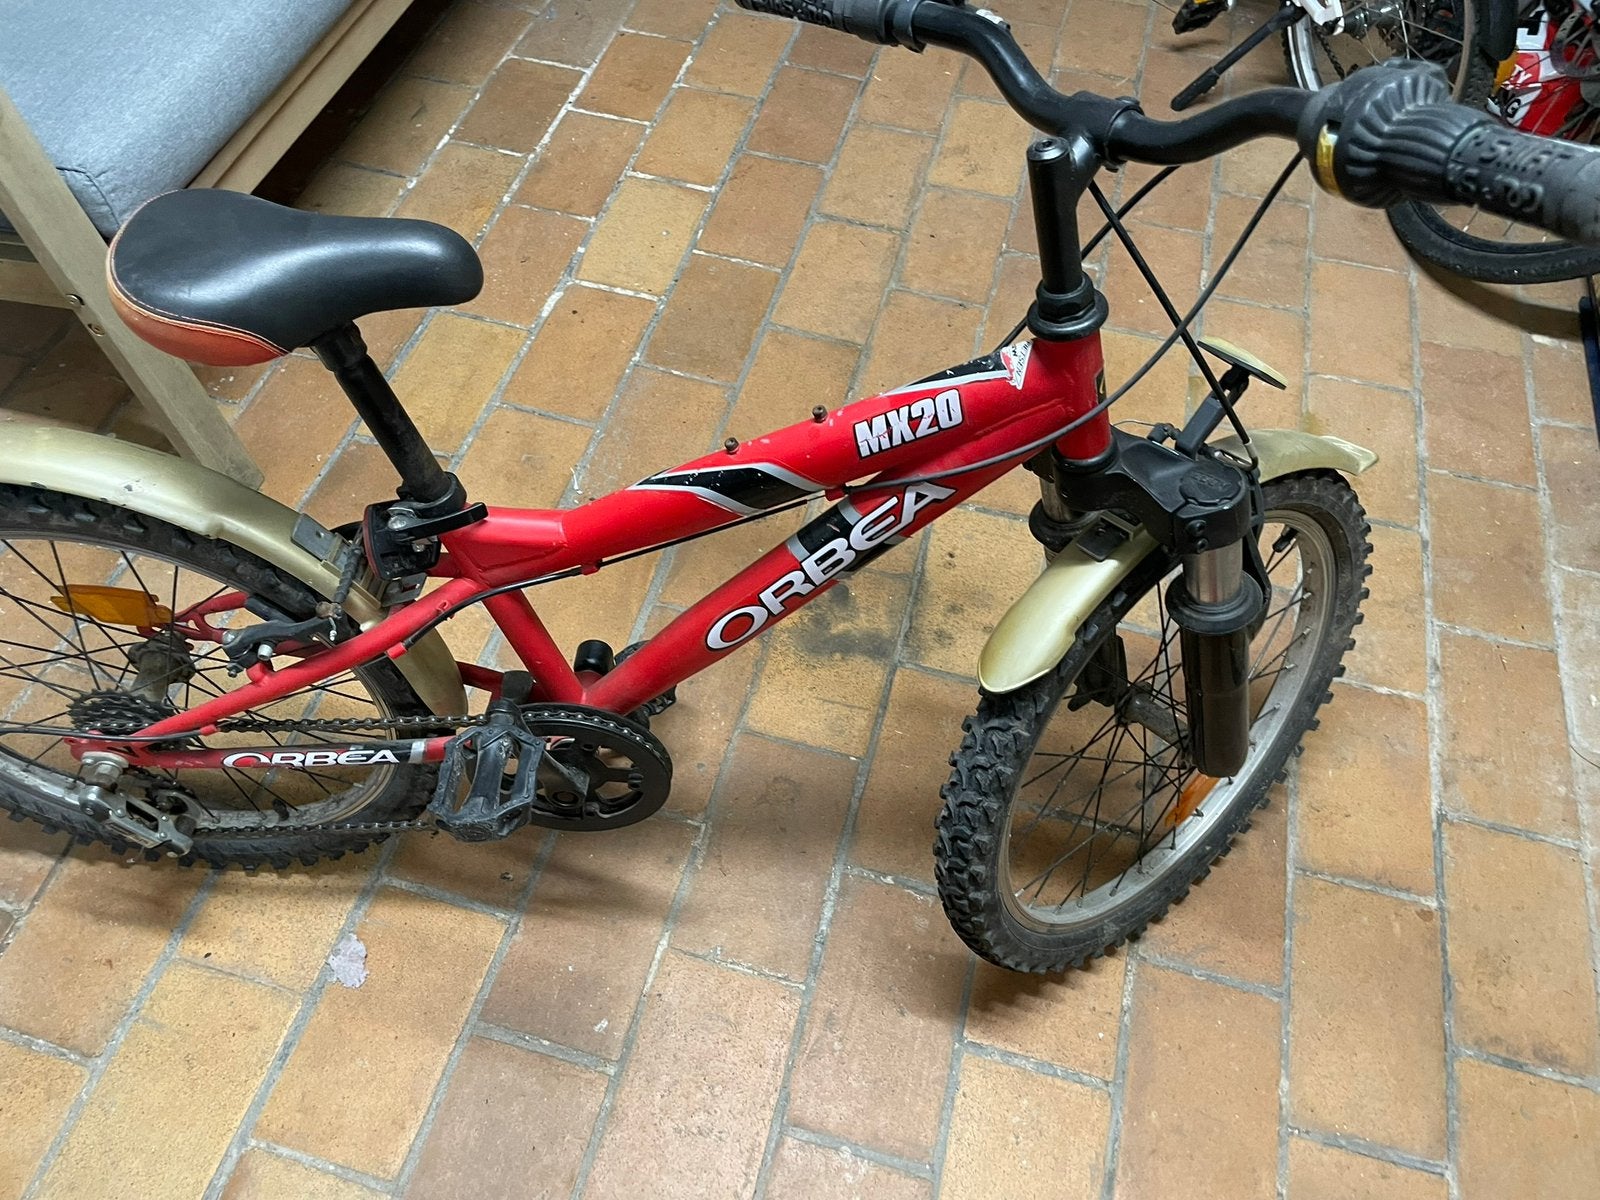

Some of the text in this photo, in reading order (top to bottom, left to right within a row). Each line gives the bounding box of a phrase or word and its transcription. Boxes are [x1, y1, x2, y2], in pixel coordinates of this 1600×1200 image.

[853, 387, 964, 459] MX20
[705, 480, 957, 650] ORBEA
[221, 749, 400, 769] ORBEA
